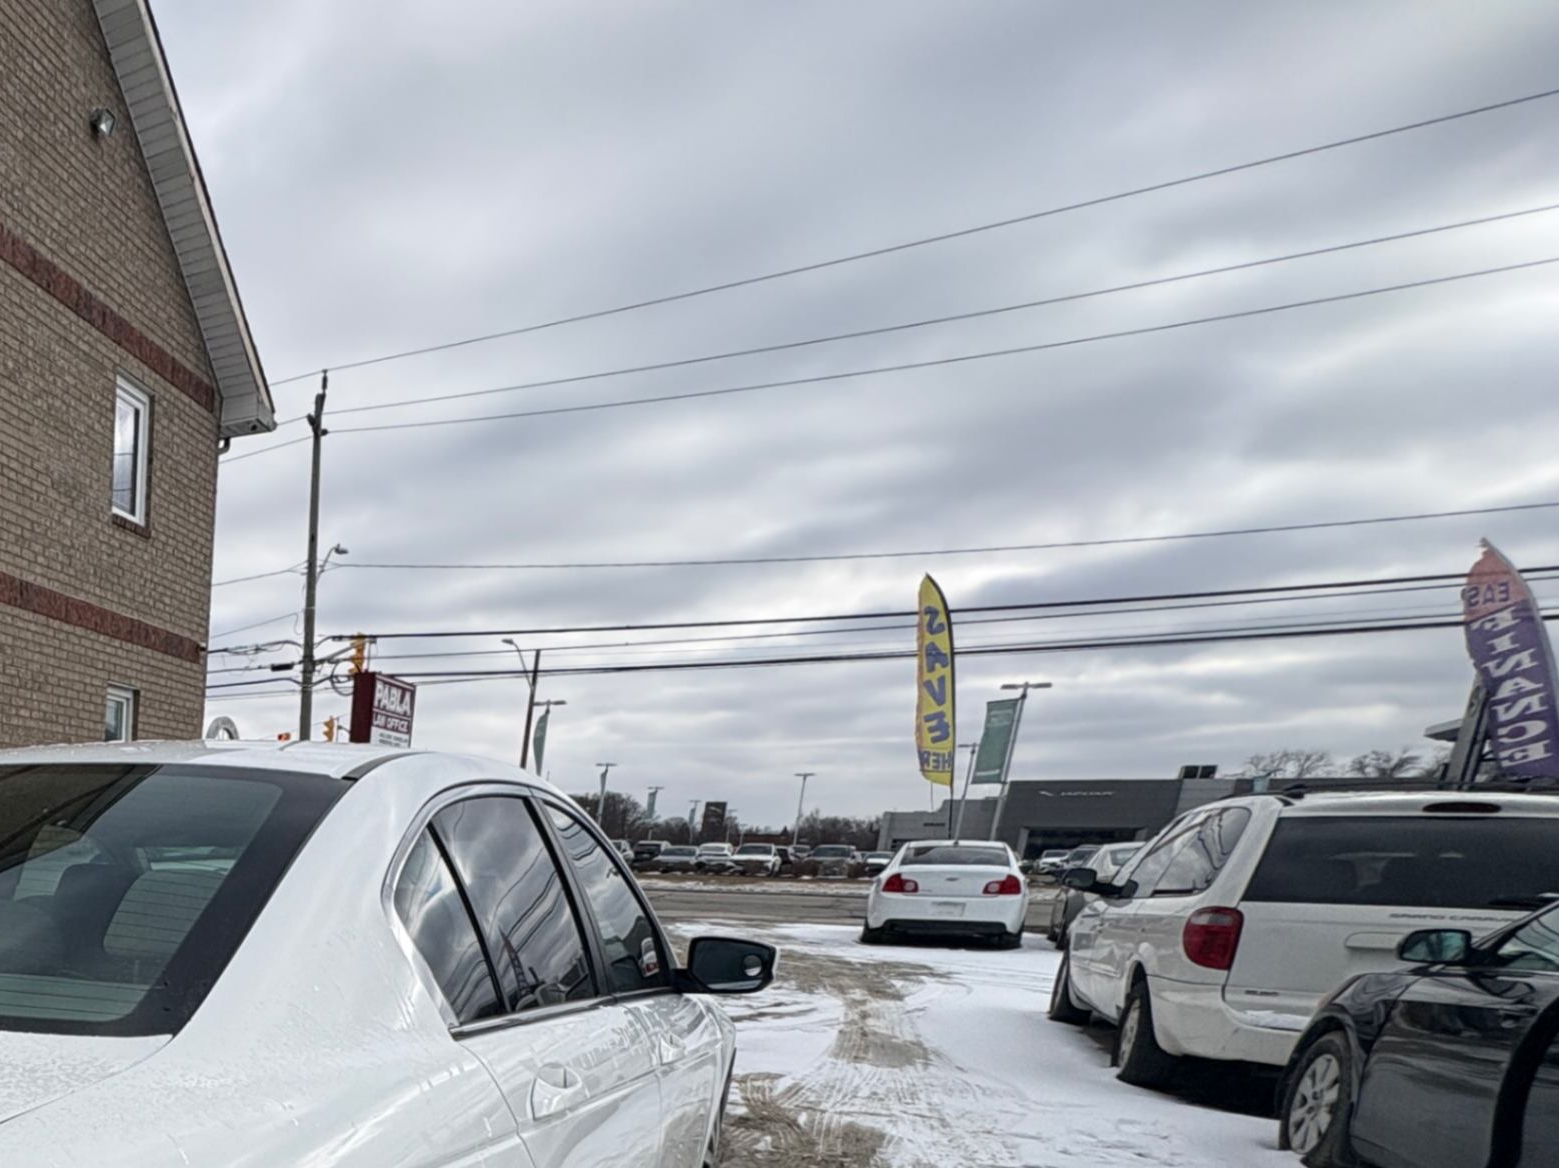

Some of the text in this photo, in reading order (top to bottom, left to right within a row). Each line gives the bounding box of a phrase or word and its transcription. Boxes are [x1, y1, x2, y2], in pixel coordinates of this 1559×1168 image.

[373, 680, 411, 717] PABLA
[372, 712, 409, 733] LAW OFFICE
